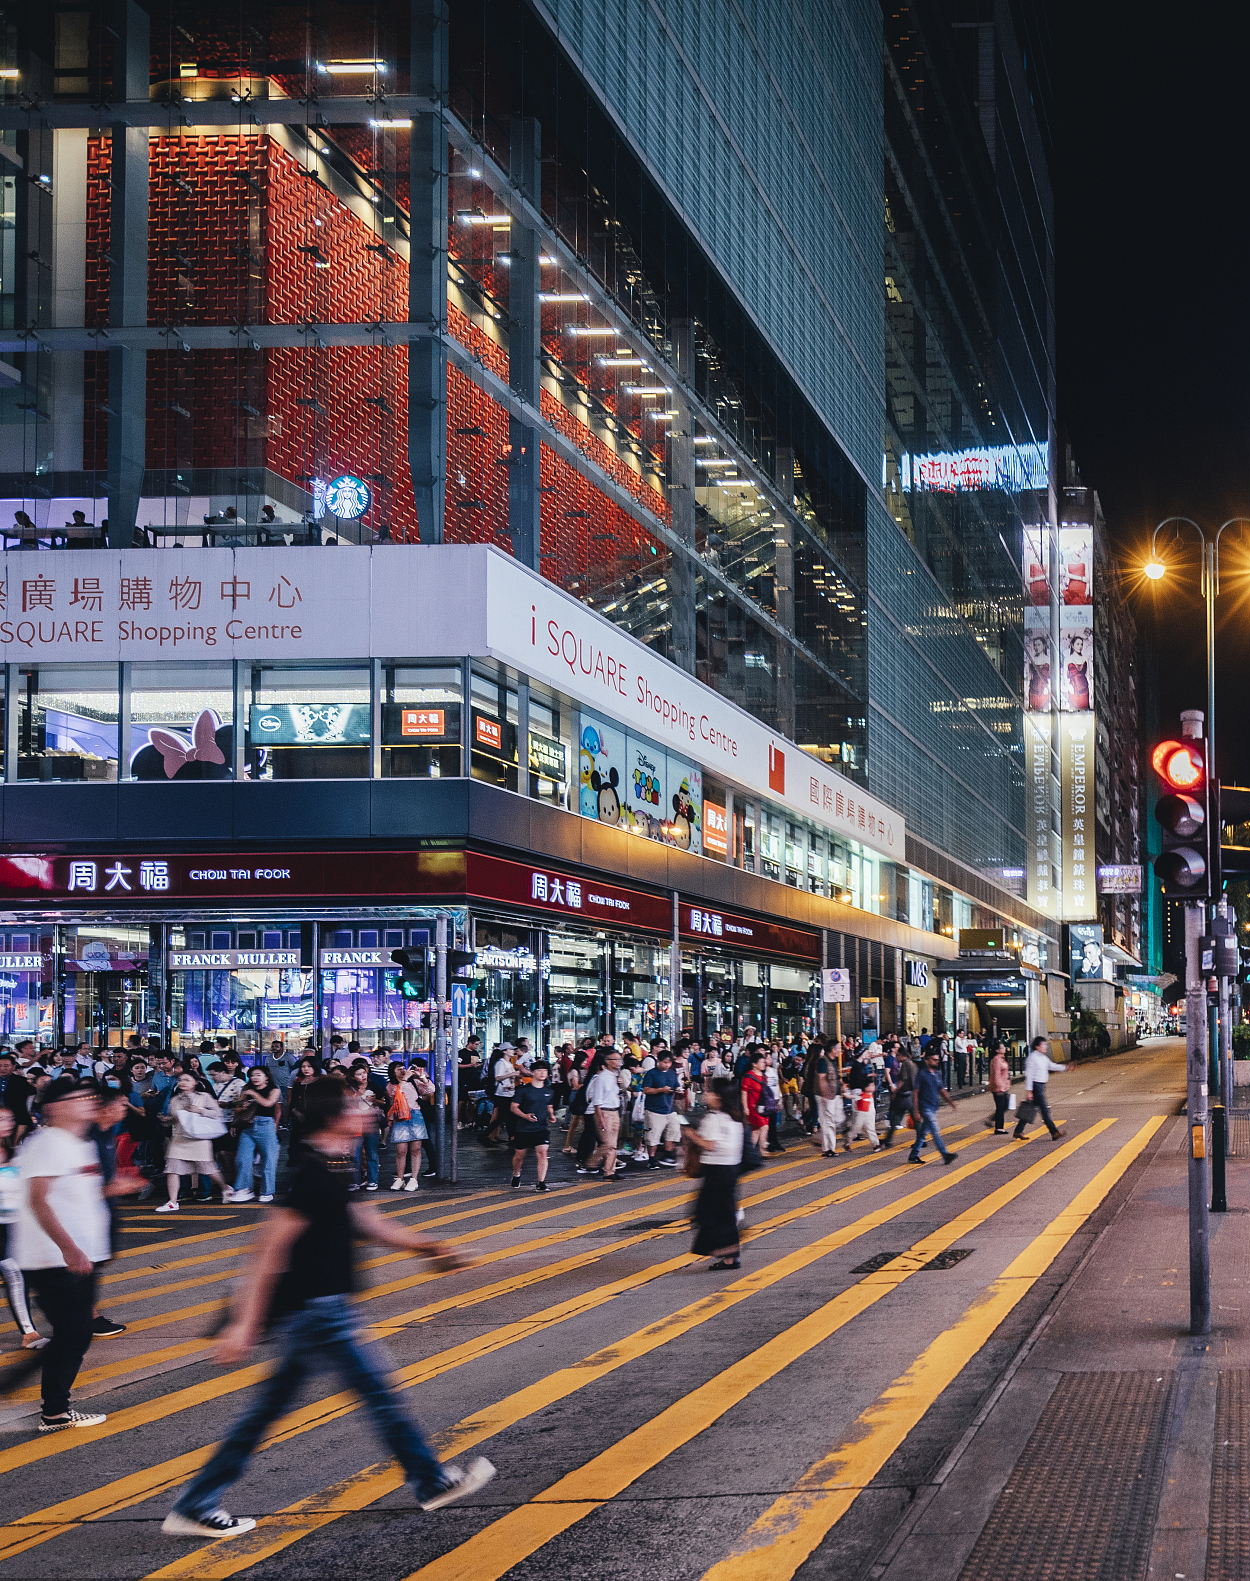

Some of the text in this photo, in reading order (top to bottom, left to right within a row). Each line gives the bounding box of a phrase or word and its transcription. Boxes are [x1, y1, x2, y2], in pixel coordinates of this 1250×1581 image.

[0, 619, 303, 648] SQUARE Shopping Centre
[547, 620, 627, 696] SQUARE
[637, 675, 696, 740] Shopping
[699, 715, 738, 758] Centre
[407, 713, 439, 724] 周大福
[1074, 743, 1086, 815] EMPEROR
[68, 860, 291, 892] 周大福 CHOW TAI FOOK
[531, 872, 582, 909] 周大福
[690, 908, 723, 936] 周大福
[173, 953, 298, 965] FRANCK MULLER
[323, 952, 382, 964] FRANCK
[911, 960, 928, 988] M&S
